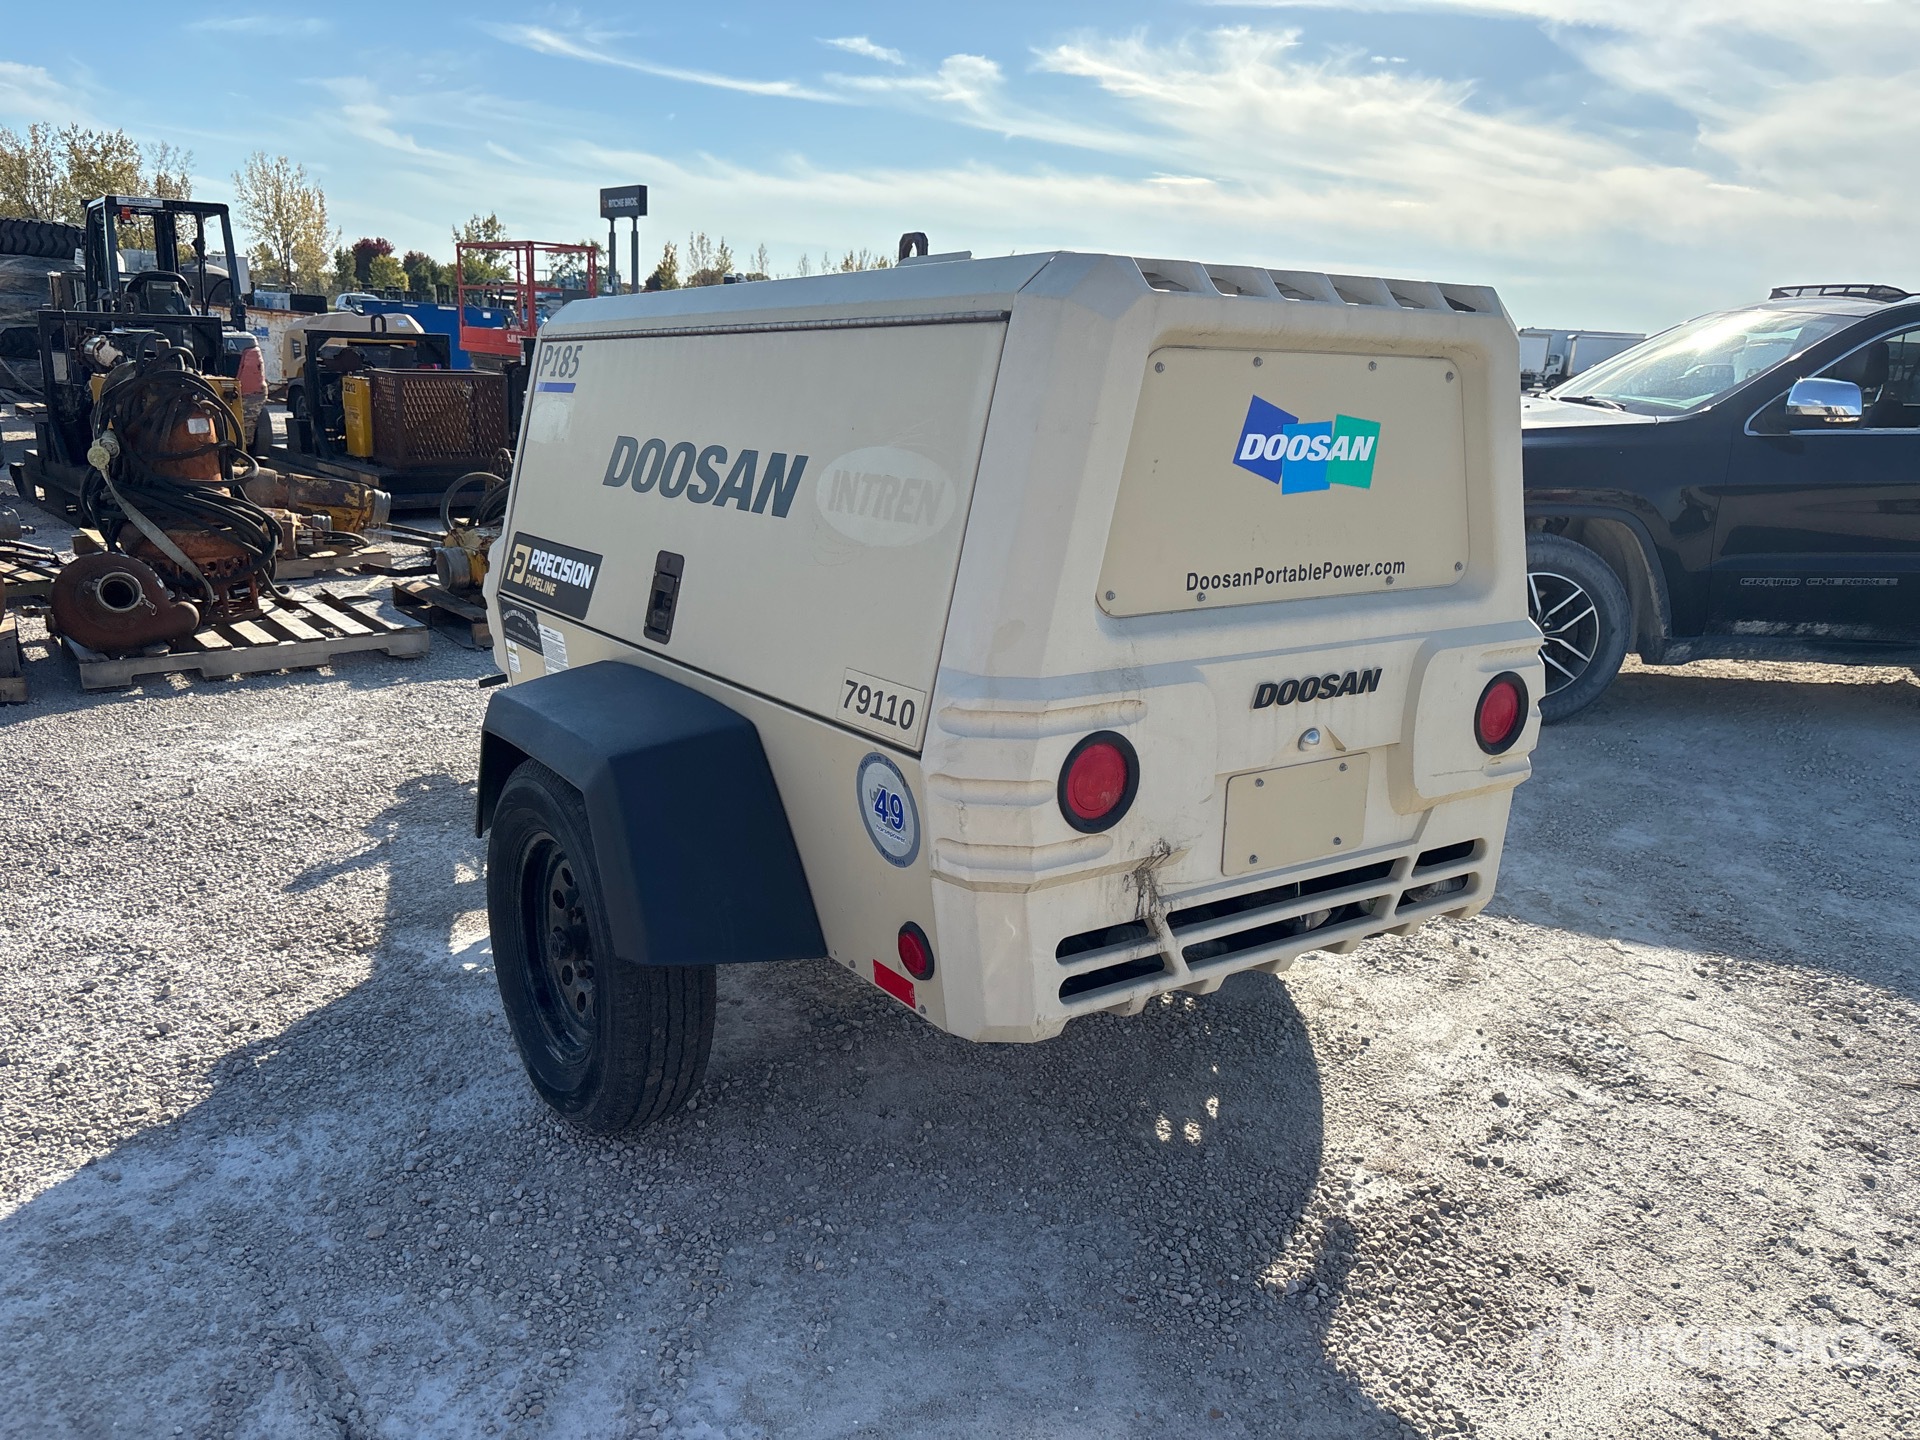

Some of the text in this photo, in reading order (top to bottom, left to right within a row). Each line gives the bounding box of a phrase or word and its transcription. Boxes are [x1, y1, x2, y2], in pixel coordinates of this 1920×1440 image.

[539, 345, 583, 379] P185
[1238, 433, 1376, 462] DOOSAN
[602, 435, 809, 519] DOOSAN
[826, 469, 946, 527] INTREN
[524, 573, 558, 597] PIPELINE
[528, 548, 596, 590] PRECISION
[1186, 560, 1406, 592] DoosanPortablePower.com
[1739, 577, 1899, 587] GRAND CHEROKEE
[843, 679, 916, 731] 79110
[1250, 667, 1383, 710] DOOSAN
[873, 787, 905, 832] 49
